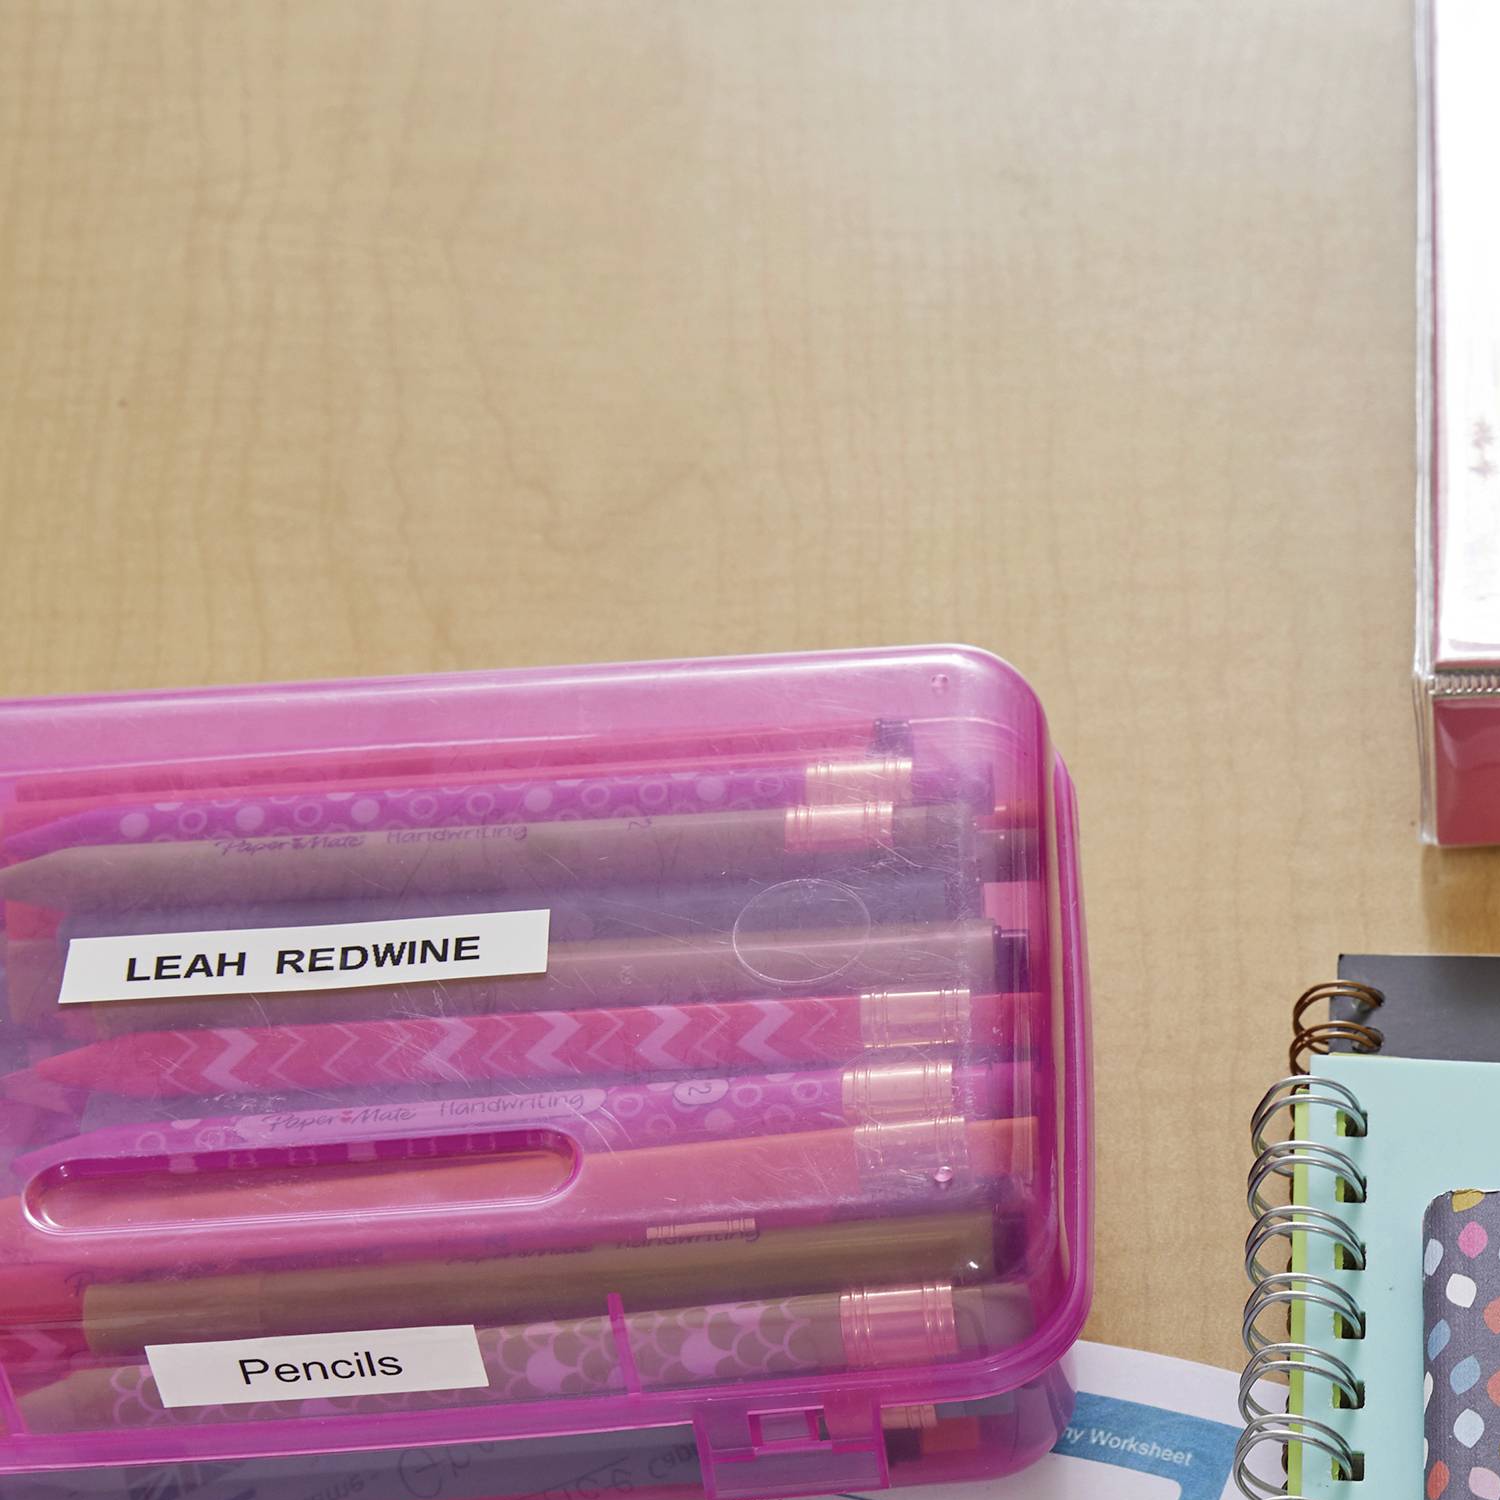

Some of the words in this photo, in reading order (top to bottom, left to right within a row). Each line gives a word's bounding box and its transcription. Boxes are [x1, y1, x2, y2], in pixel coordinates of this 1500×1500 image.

[125, 951, 247, 982] LEAH
[274, 935, 482, 975] REDWINE
[261, 1112, 338, 1134] Paper
[351, 1107, 417, 1126] Mate
[439, 1091, 586, 1117] Handwriting
[237, 1349, 404, 1386] Pencils
[1088, 1429, 1193, 1467] Worksheet
